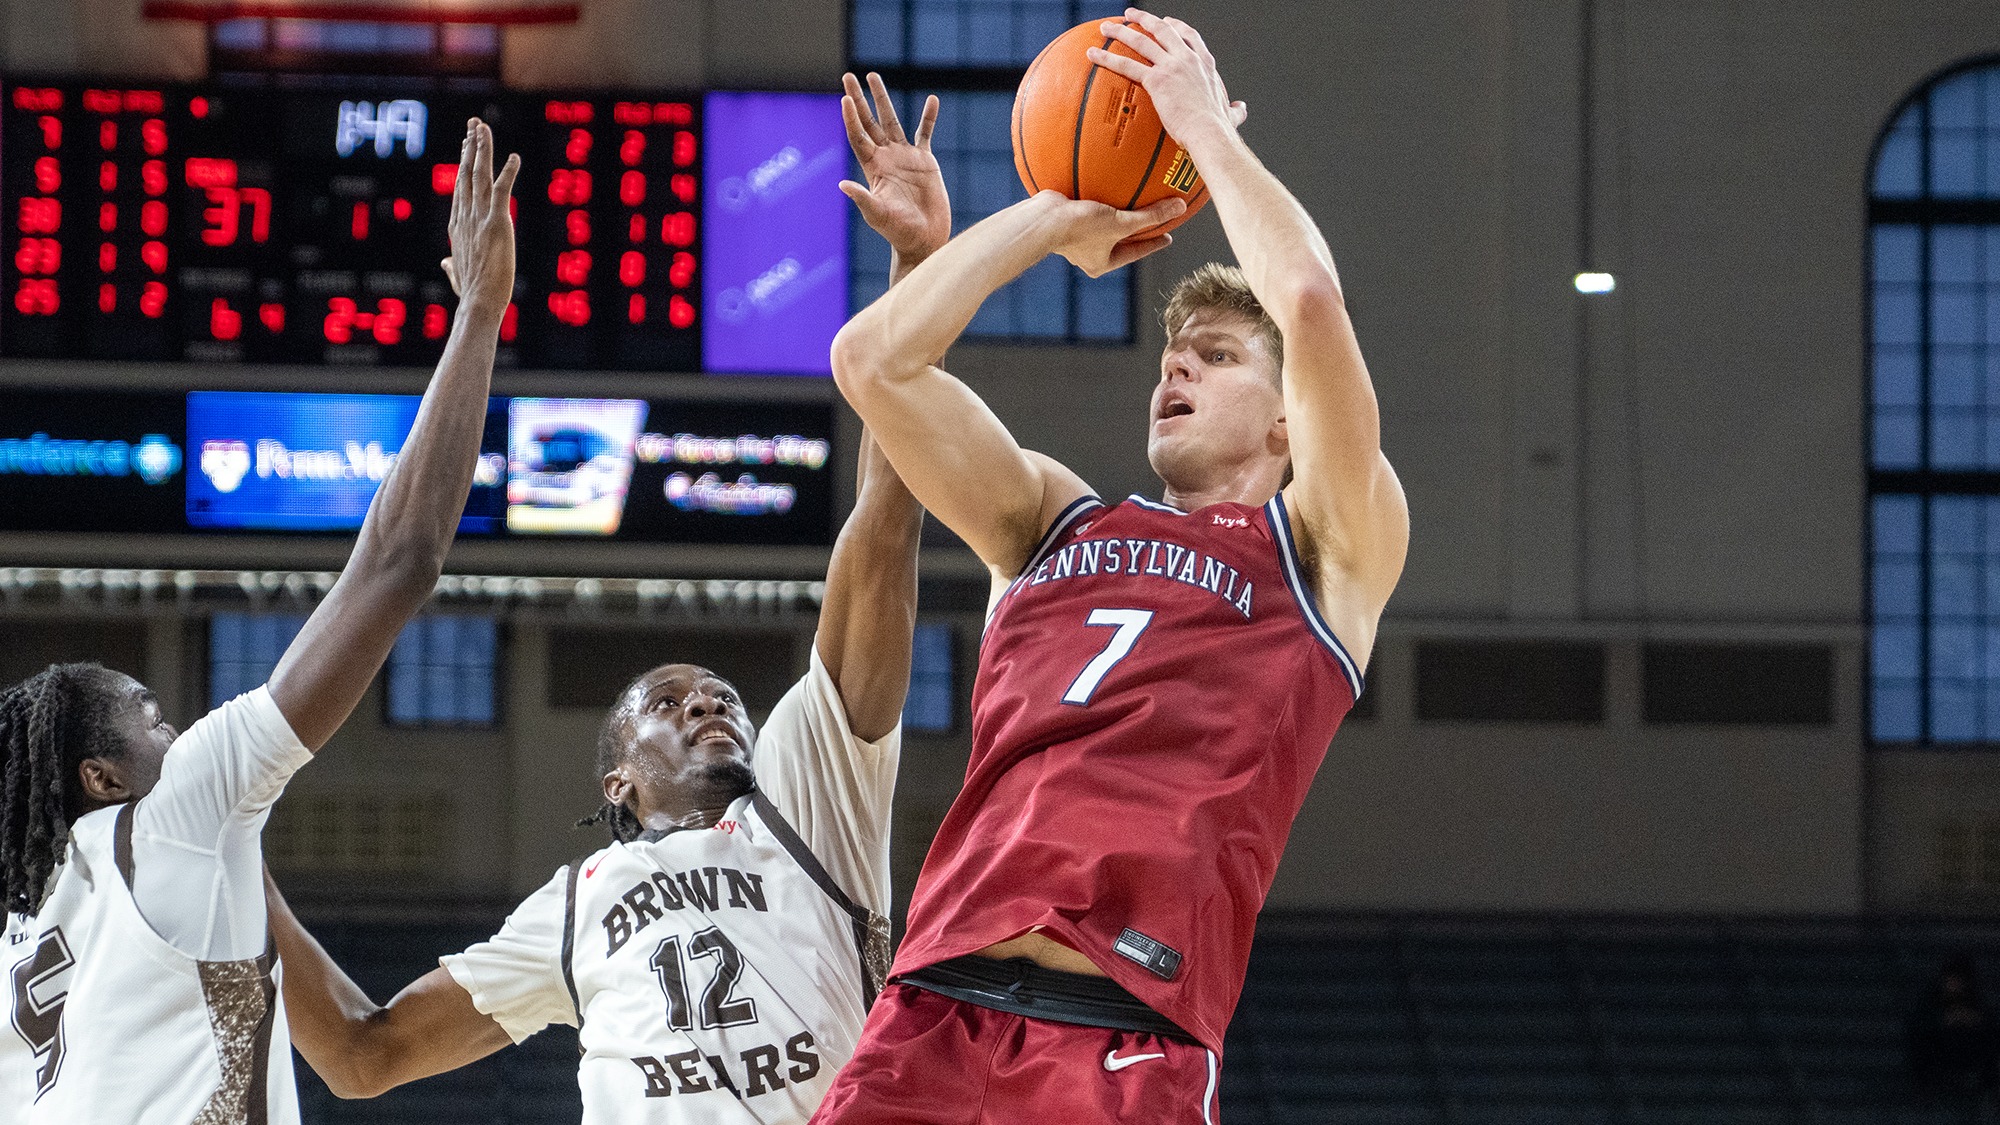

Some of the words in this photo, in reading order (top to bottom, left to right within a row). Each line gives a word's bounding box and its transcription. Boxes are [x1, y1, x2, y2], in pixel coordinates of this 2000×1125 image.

[201, 187, 272, 246] 37
[1212, 514, 1236, 528] Ivy
[1060, 608, 1156, 706] 7
[713, 820, 737, 835] vy
[602, 866, 769, 960] BROWN
[649, 924, 759, 1033] 12
[1158, 954, 1167, 968] L
[10, 924, 77, 1106] 5
[629, 1030, 821, 1100] BEARS
